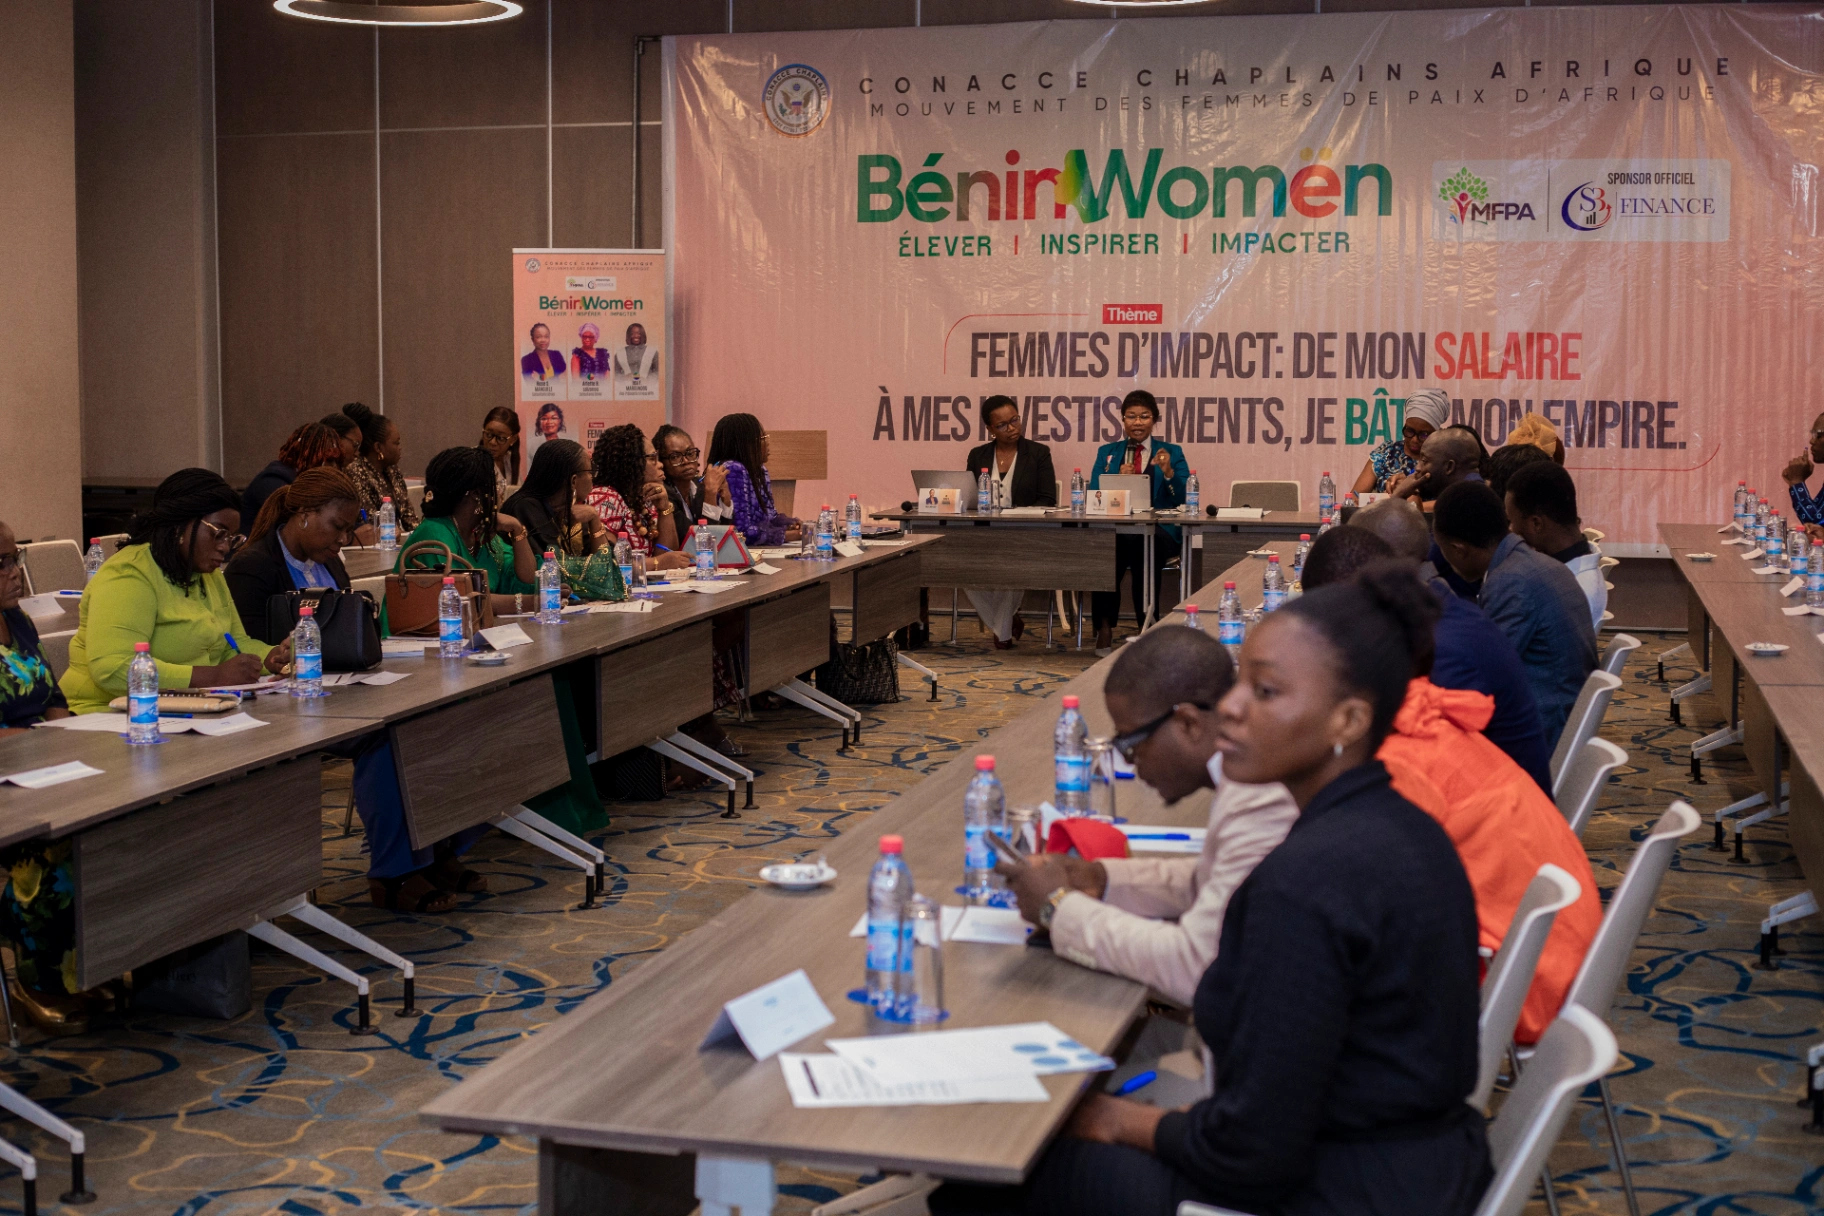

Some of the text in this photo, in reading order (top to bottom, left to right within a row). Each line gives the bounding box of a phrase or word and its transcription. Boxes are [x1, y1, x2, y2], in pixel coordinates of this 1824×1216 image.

[859, 57, 1729, 94] CONACCE CHAPLAINS AFRIQUE
[870, 85, 1714, 117] MOUVEMENT DES FEMMES DE PAIX D'AFRIQUE
[1608, 172, 1695, 185] SPONSOR OFFICIEL
[1471, 202, 1536, 222] MFPA
[1621, 197, 1716, 215] FINANCE
[898, 230, 1350, 257] ÉLEVER INSPIRER IMPACTER
[1107, 307, 1158, 321] Thème
[970, 331, 1582, 380] FEMMES D'IMPACT: DE MON SALAIRE
[872, 385, 896, 441] À
[902, 395, 972, 442] MES
[1300, 397, 1338, 445] JE
[1543, 399, 1687, 450] EMPIRE.
